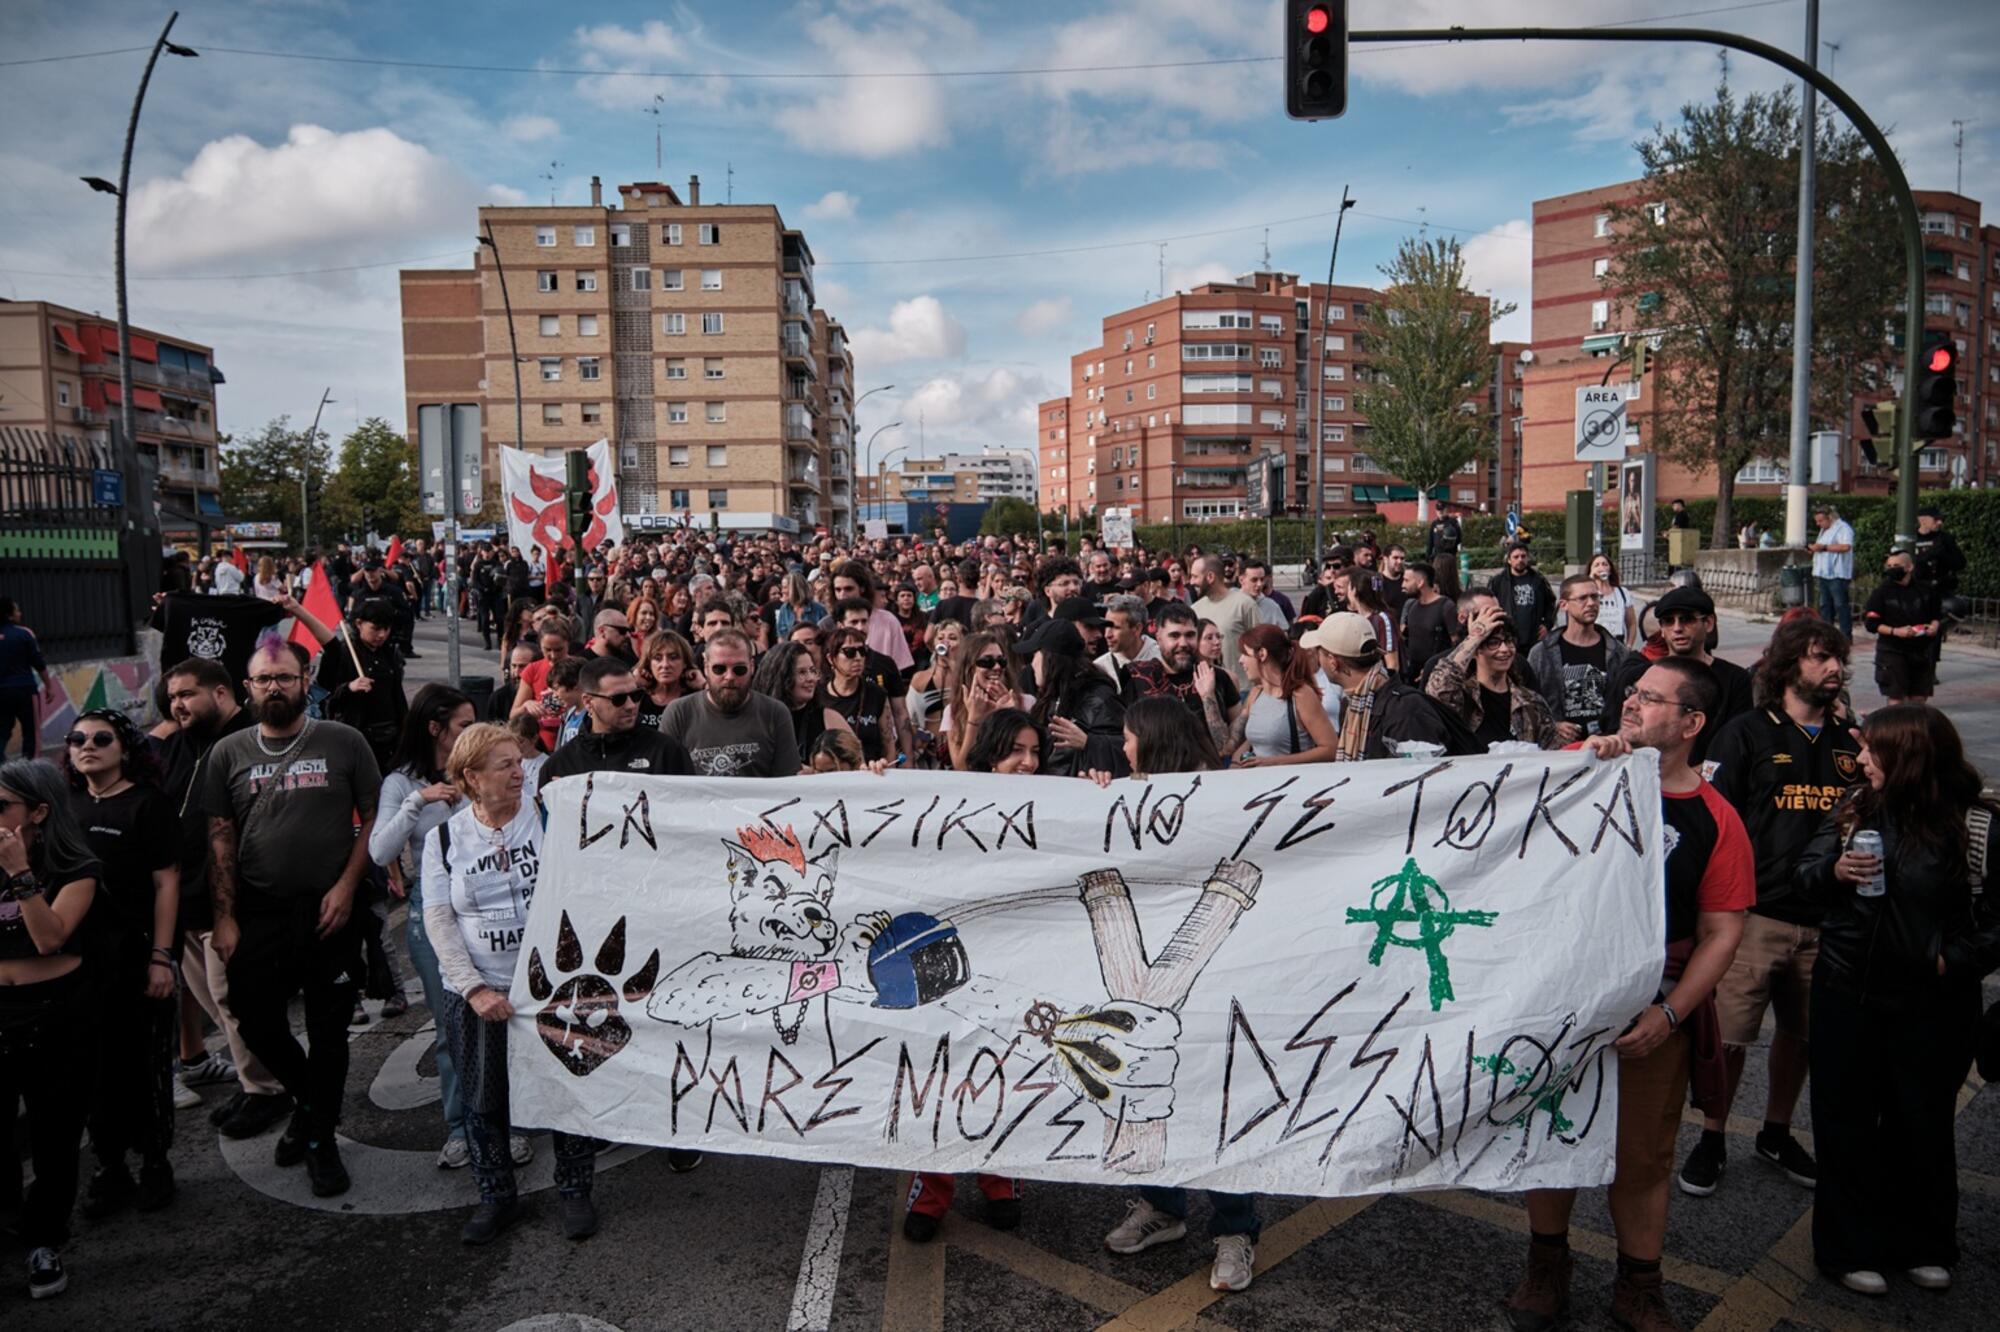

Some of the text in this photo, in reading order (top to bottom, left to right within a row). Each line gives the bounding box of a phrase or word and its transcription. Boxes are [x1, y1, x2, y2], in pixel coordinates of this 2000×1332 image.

[1587, 420, 1615, 436] 30
[1783, 784, 1847, 797] SHARP
[579, 761, 1644, 860] LA CASIKA NO SE TOKA
[1774, 796, 1839, 811] VIEWC
[466, 866, 477, 875] LA
[671, 1032, 1059, 1166] PAREMOS
